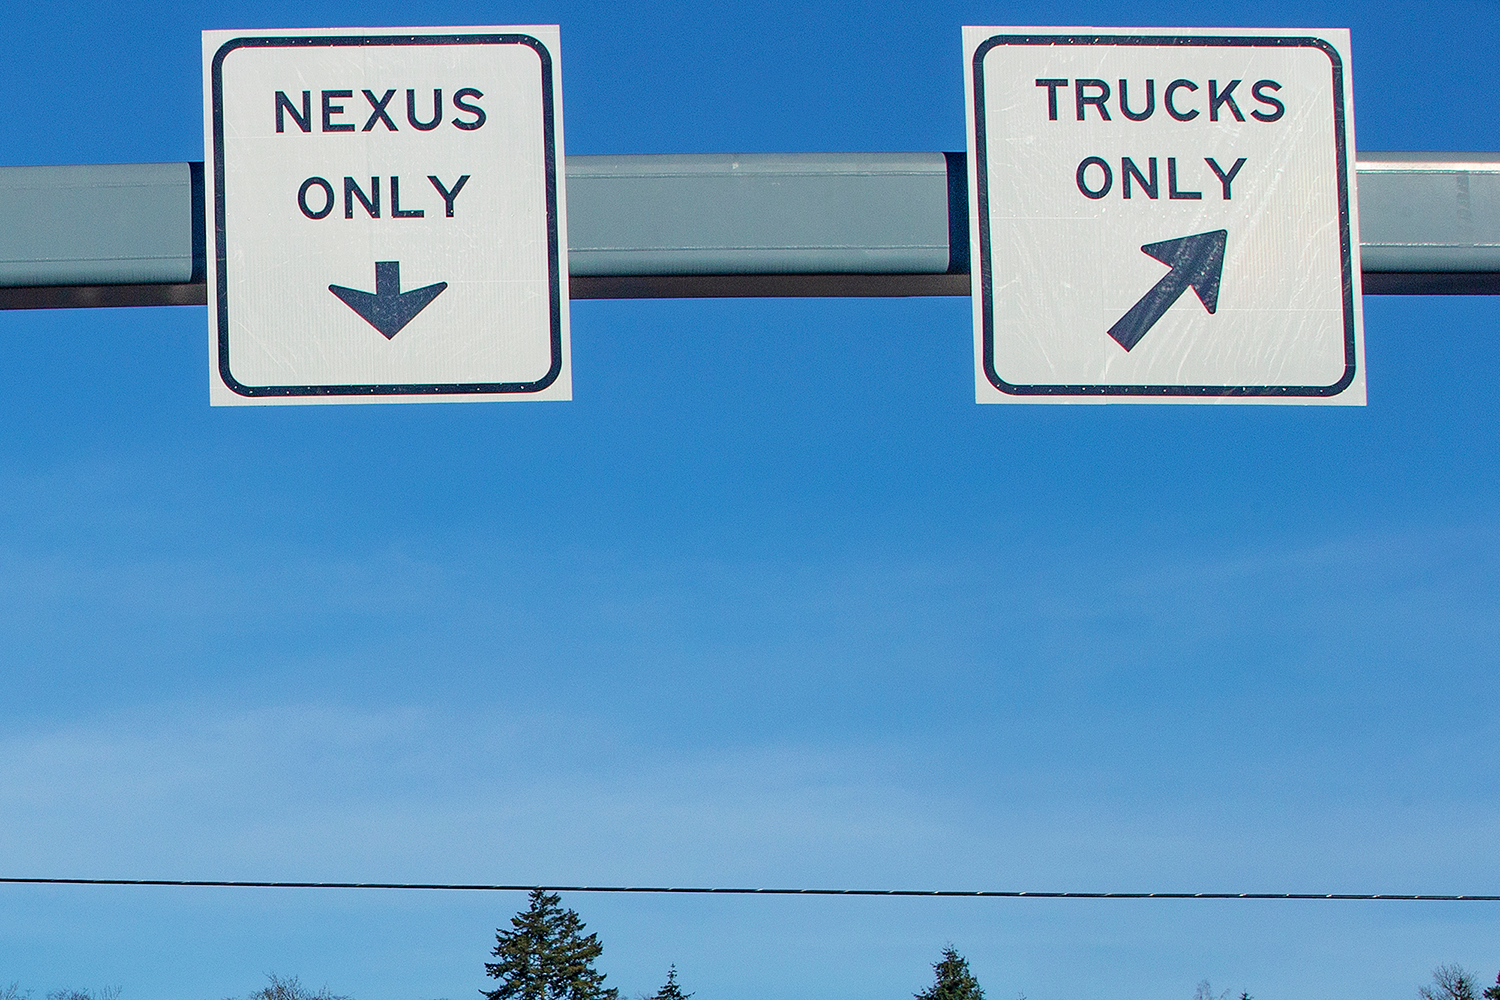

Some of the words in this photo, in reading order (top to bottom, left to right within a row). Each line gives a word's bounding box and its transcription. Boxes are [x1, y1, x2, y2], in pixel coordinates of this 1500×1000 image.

[274, 87, 487, 134] NEXUS
[1035, 78, 1285, 123] TRUCKS
[297, 174, 471, 220] ONLY
[1075, 156, 1248, 201] ONLY
